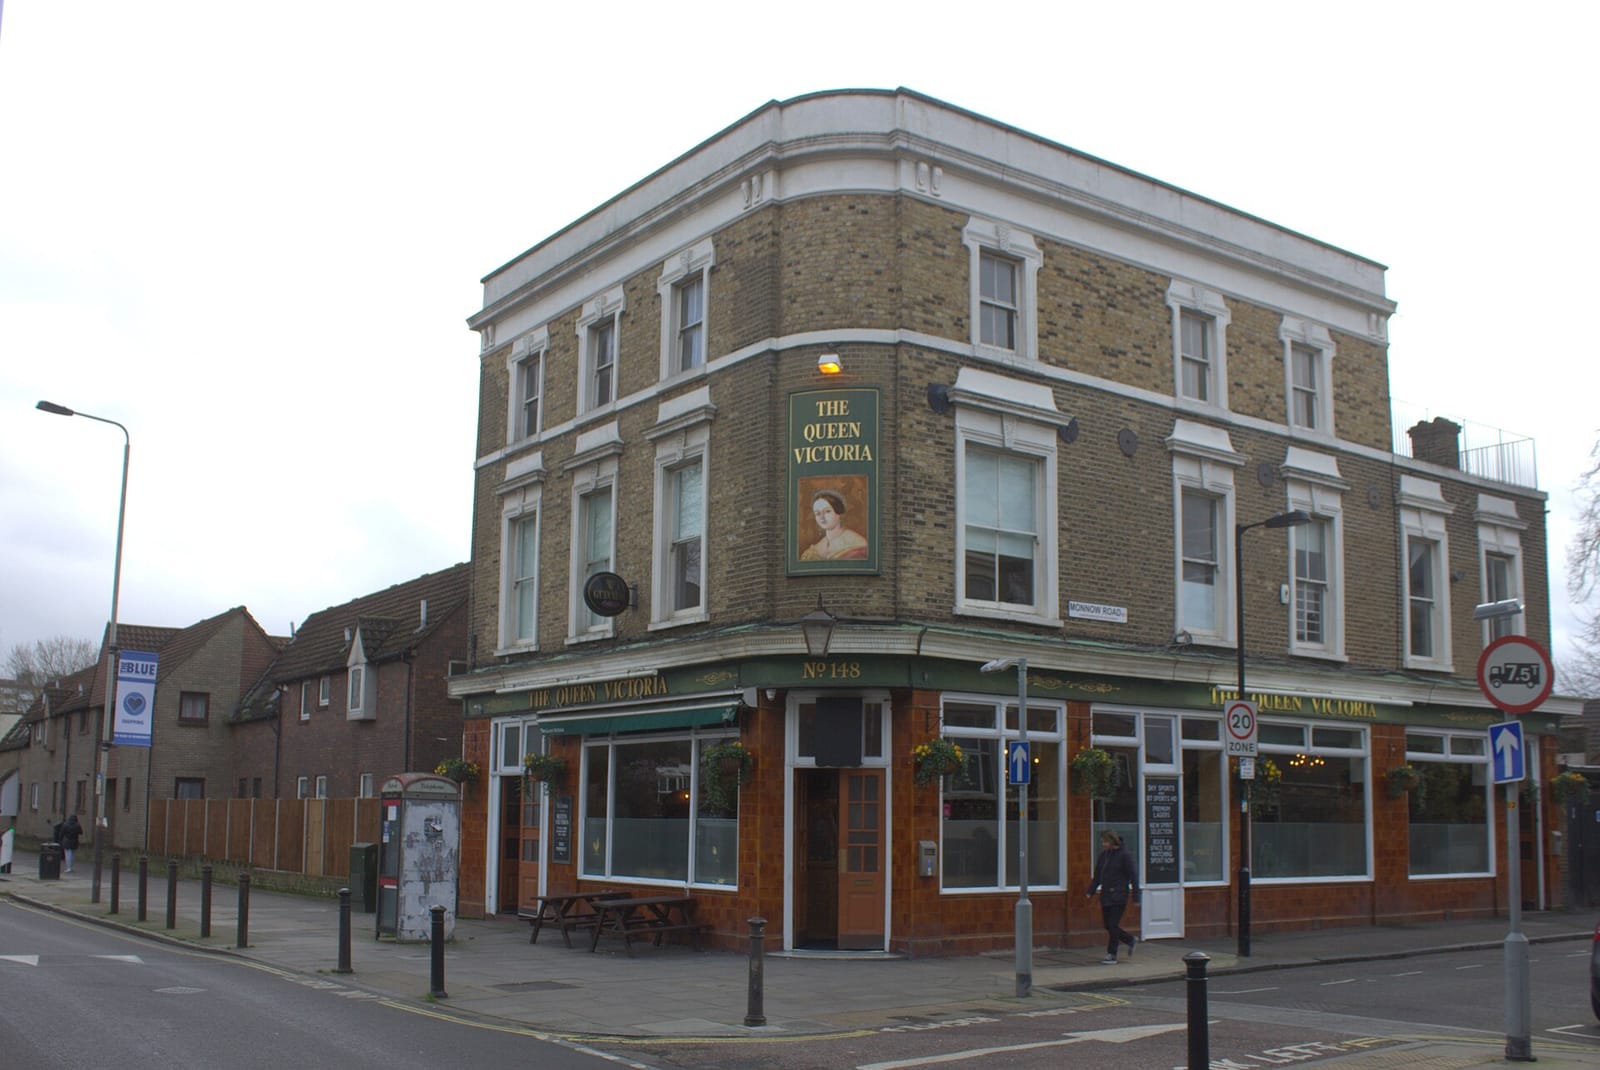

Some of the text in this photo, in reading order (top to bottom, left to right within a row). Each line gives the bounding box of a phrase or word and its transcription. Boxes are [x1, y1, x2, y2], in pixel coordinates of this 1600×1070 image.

[816, 400, 850, 417] THE
[803, 422, 861, 442] QUEEN
[794, 444, 873, 464] VICTORIA
[1070, 602, 1101, 614] MONNOW
[1102, 606, 1121, 617] ROAD
[127, 662, 156, 676] BLUE
[831, 662, 861, 678] 148
[528, 675, 668, 708] THE QUEEN VICTORIA
[1252, 693, 1302, 712] QUEEN
[1311, 697, 1377, 718] VICTORIA
[1231, 714, 1251, 729] 20
[1229, 742, 1255, 753] ZONE
[1244, 1041, 1348, 1064] LEFT
